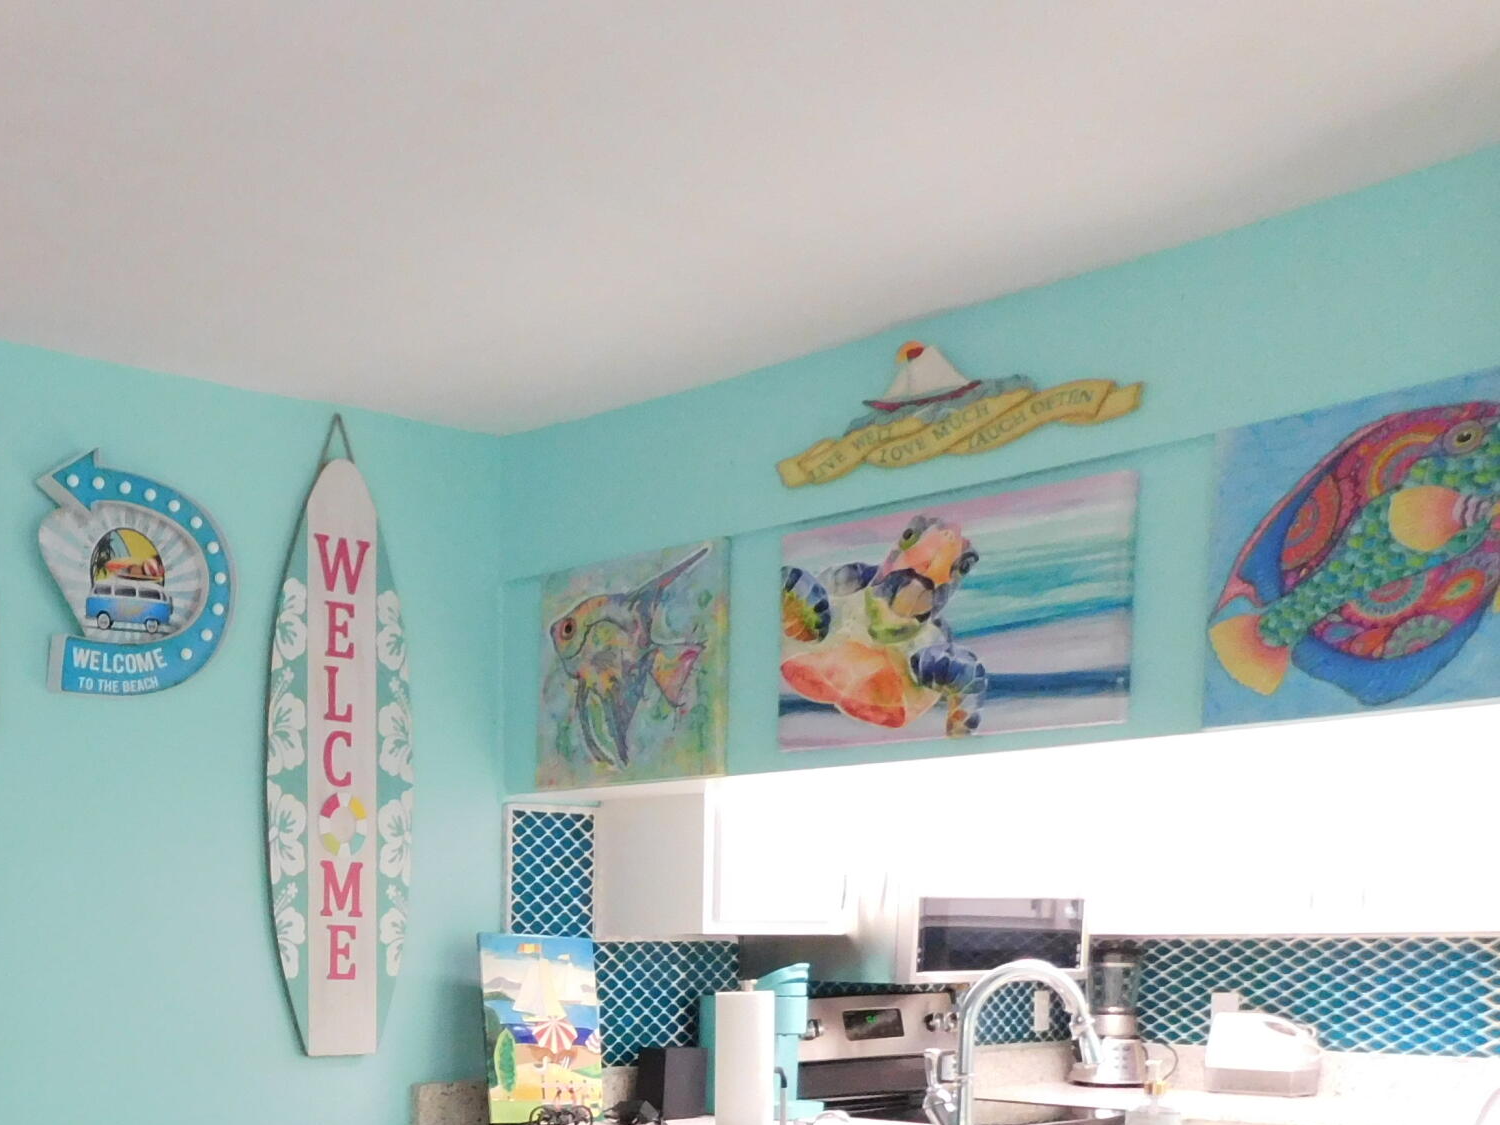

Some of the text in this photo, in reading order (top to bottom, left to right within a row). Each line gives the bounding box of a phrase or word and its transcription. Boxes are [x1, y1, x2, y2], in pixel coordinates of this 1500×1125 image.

[878, 402, 989, 464] LOVE MUCH
[967, 388, 1094, 450] LAUGH OFTEN
[808, 449, 846, 482] LIVE
[72, 646, 168, 674] WELCOME
[78, 676, 159, 694] TO THE BEACH
[314, 532, 371, 981] WELCOME
